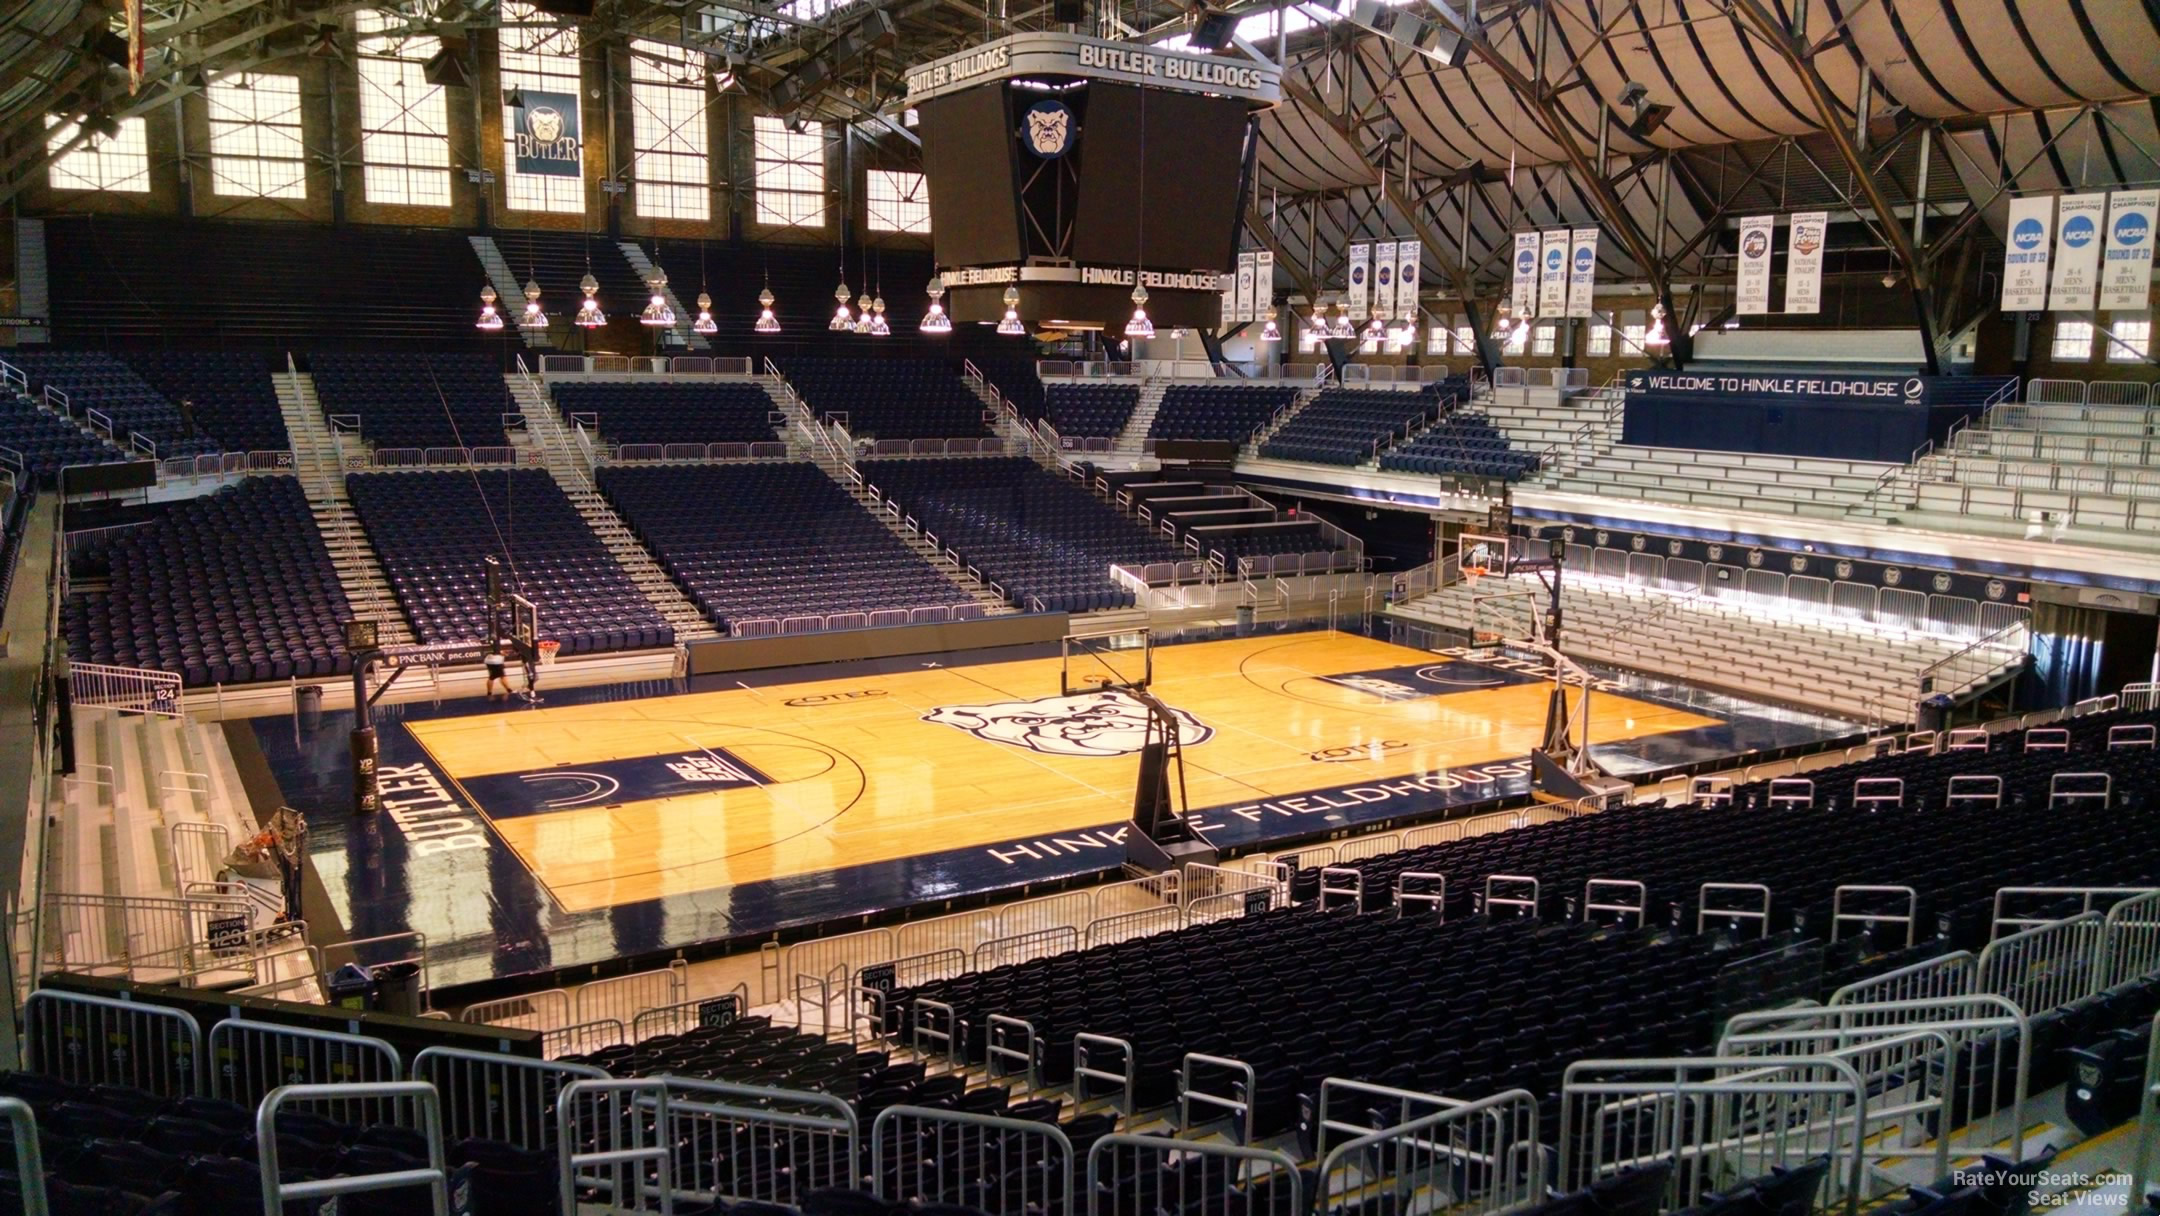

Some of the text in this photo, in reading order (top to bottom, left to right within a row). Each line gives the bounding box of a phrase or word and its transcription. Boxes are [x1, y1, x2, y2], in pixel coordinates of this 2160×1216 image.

[908, 46, 1009, 95] BUTLER BULLDOGS
[1078, 45, 1263, 90] BUTLER BULLDOGS
[515, 132, 578, 162] BUTLER
[2062, 204, 2101, 212] CHAMPIONS
[2112, 201, 2156, 209] CHAMPIONS
[2016, 233, 2042, 243] NCAA
[2065, 231, 2093, 241] NCAA
[2117, 228, 2147, 238] NCAA
[2007, 252, 2046, 264] ROUND OF 32
[2107, 248, 2151, 260] ROUND OF 32
[1575, 258, 1592, 266] NCAA
[941, 266, 1017, 286] HINKLE FIELDHOUSE
[1082, 267, 1217, 290] HINKLE FIELDHOUSE
[1543, 272, 1558, 282] SWEET
[1572, 273, 1588, 283] SWEET
[2004, 288, 2042, 296] BASKETBALL
[2052, 287, 2091, 295] BASKETBALL
[2104, 285, 2146, 294] BASKETBALL
[1648, 376, 1899, 397] WELCOME TO HINKLE FIELDHOUSE
[277, 457, 292, 465] 204
[448, 651, 481, 660] pnc.com
[156, 689, 175, 700] 124
[664, 763, 714, 781] BIG
[682, 756, 740, 781] EAST
[376, 762, 491, 857] BUTLER
[987, 815, 1226, 864] HINKE
[209, 919, 244, 930] SECTION
[863, 968, 895, 980] SECTION
[701, 1001, 735, 1014] SECTION
[704, 1011, 732, 1028] 120
